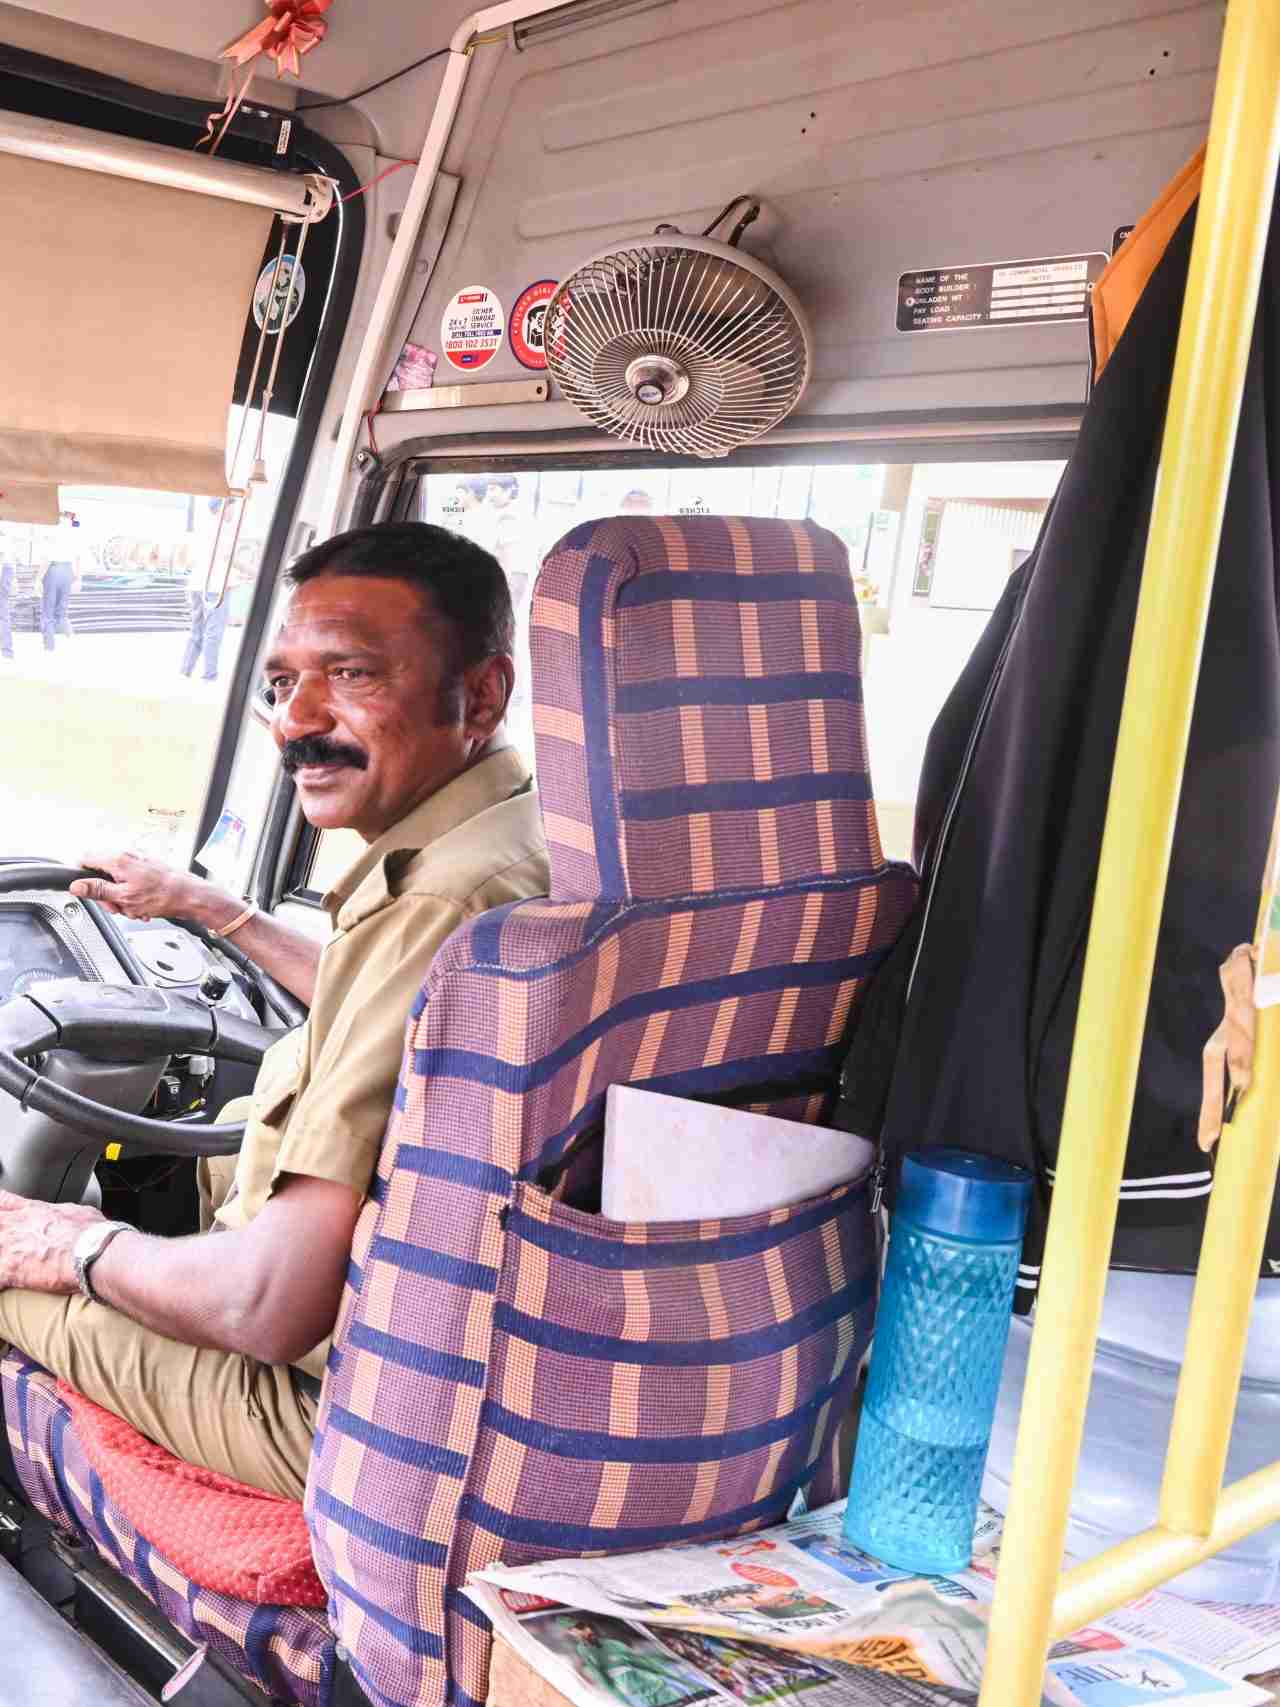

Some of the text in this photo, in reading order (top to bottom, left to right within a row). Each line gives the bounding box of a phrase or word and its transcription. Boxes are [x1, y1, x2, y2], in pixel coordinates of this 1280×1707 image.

[940, 274, 950, 282] OF
[954, 273, 968, 281] THE
[915, 284, 969, 295] BODY BUILDER
[930, 305, 951, 314] LOAD
[945, 313, 981, 322] CAPACITY
[470, 321, 493, 329] SERVICE
